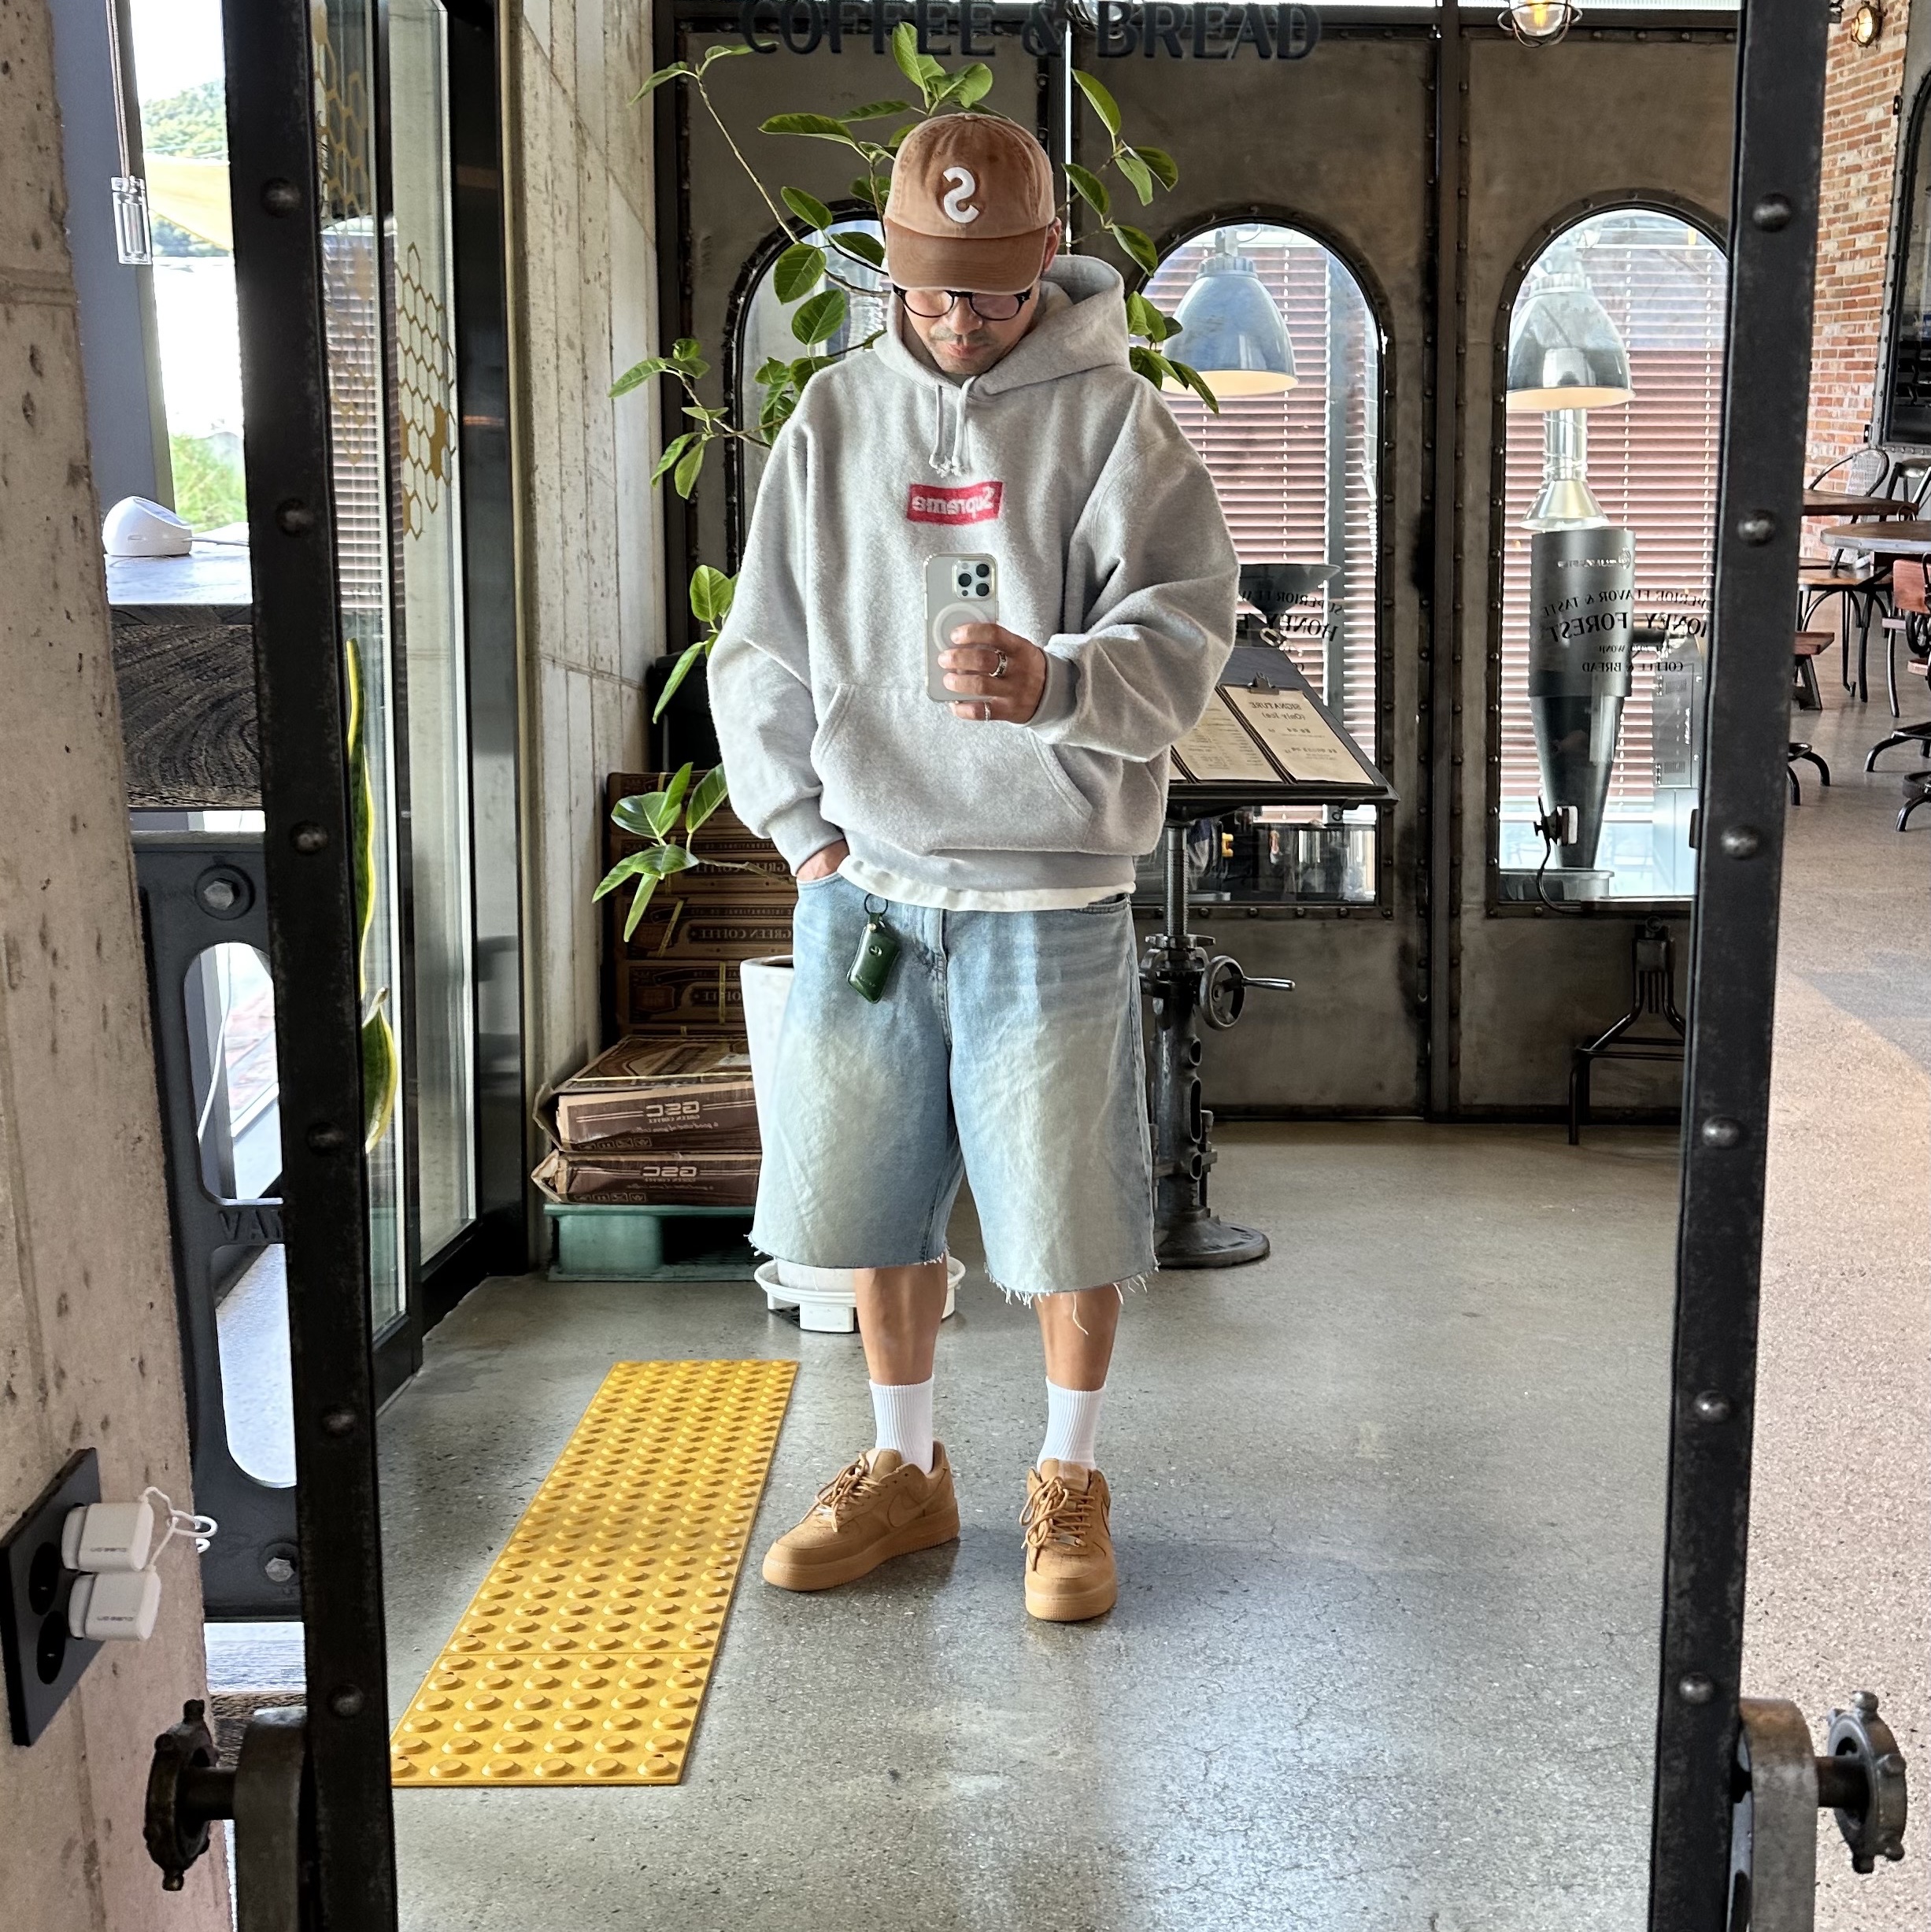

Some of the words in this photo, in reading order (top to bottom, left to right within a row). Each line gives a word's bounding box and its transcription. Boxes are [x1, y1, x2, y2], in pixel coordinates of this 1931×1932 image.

[740, 0, 997, 56] COFFEE
[1022, 0, 1067, 57] &
[1097, 2, 1321, 60] BREAD
